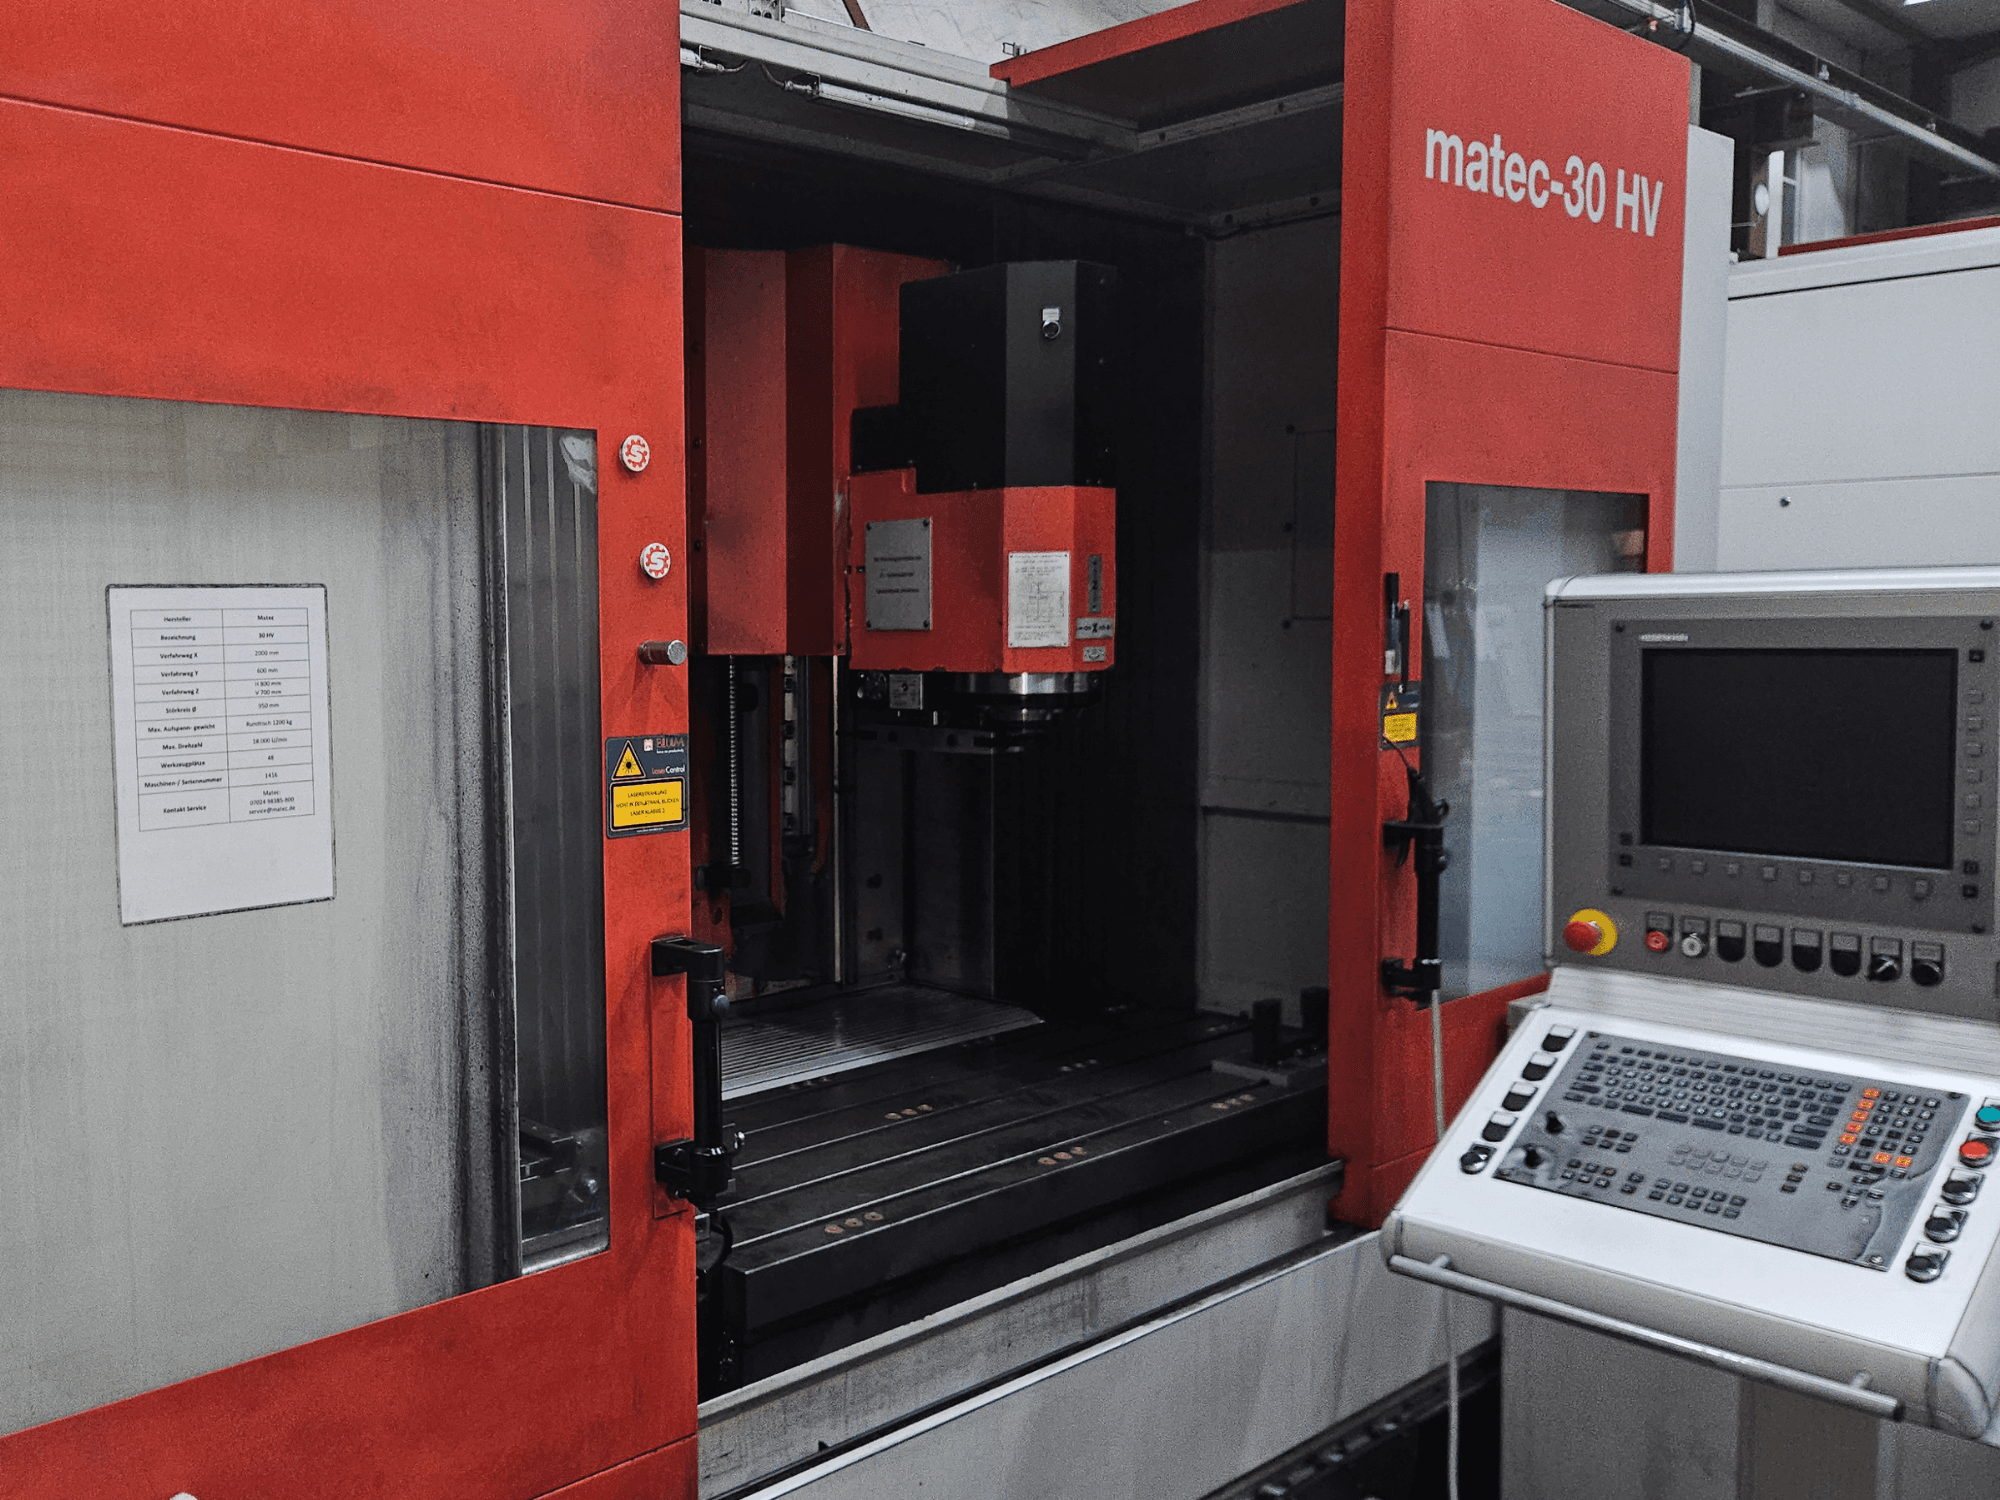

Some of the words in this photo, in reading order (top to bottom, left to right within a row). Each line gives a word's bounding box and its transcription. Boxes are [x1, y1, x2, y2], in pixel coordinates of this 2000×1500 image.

[1425, 128, 1606, 224] matec-30
[1615, 168, 1663, 237] HV
[160, 634, 196, 642] Bezeichnung
[193, 723, 215, 732] gewicht
[160, 760, 206, 769] Werkzeugplätze
[186, 804, 207, 812] Service
